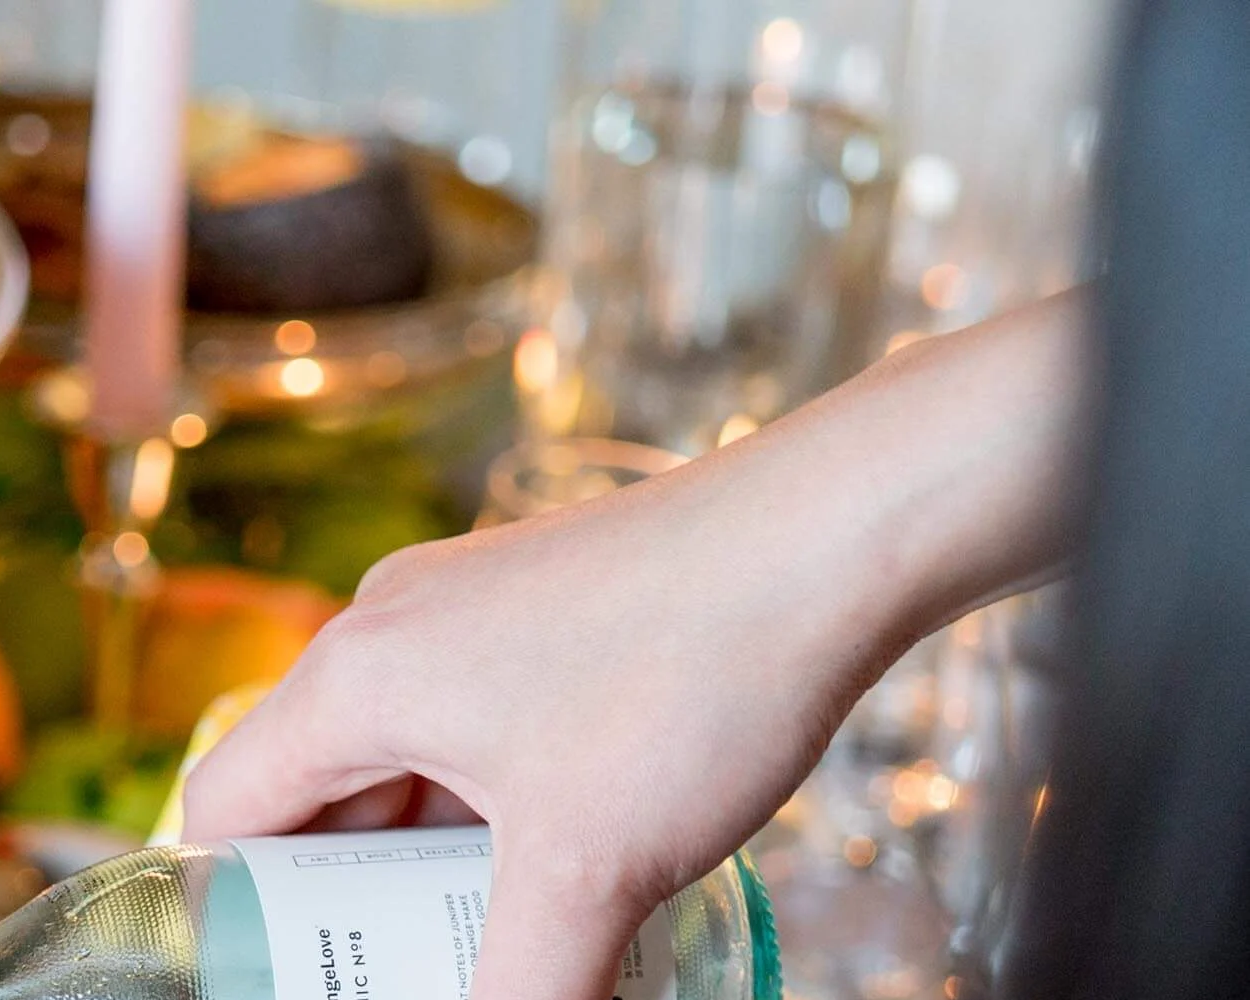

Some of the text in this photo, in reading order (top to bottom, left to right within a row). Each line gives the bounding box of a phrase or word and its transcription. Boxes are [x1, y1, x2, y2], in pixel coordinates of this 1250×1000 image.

[444, 893, 460, 932] JUNIPER
[472, 890, 485, 918] GOOD
[453, 936, 463, 950] OF
[459, 895, 478, 967] ORANGE MAKE
[456, 953, 468, 989] NOTES
